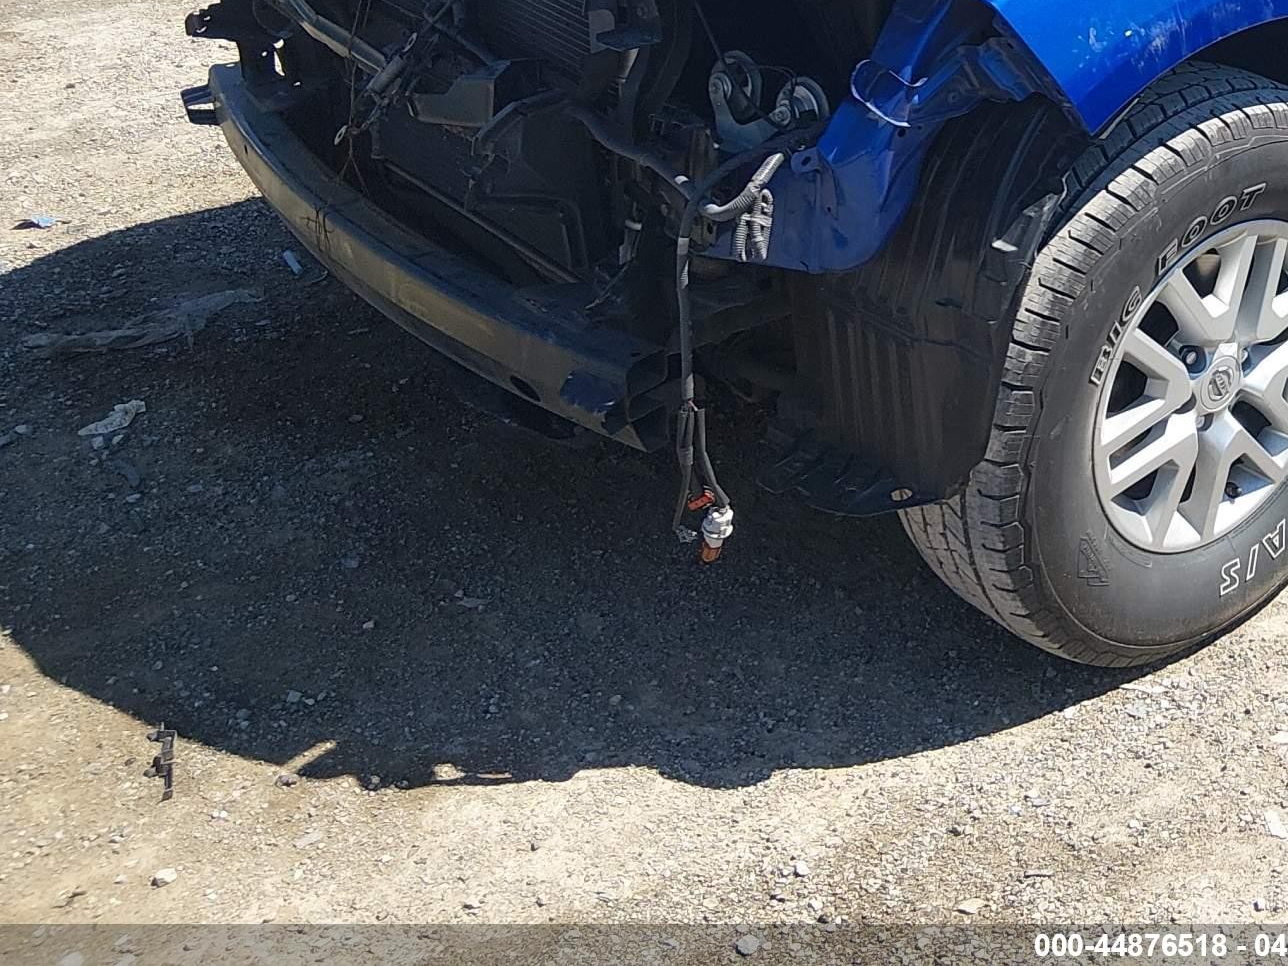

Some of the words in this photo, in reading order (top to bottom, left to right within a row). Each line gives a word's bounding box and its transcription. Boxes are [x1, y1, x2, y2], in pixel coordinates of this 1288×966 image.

[1088, 285, 1144, 385] BIG
[1156, 182, 1267, 276] FOOT
[1218, 517, 1287, 597] A/S
